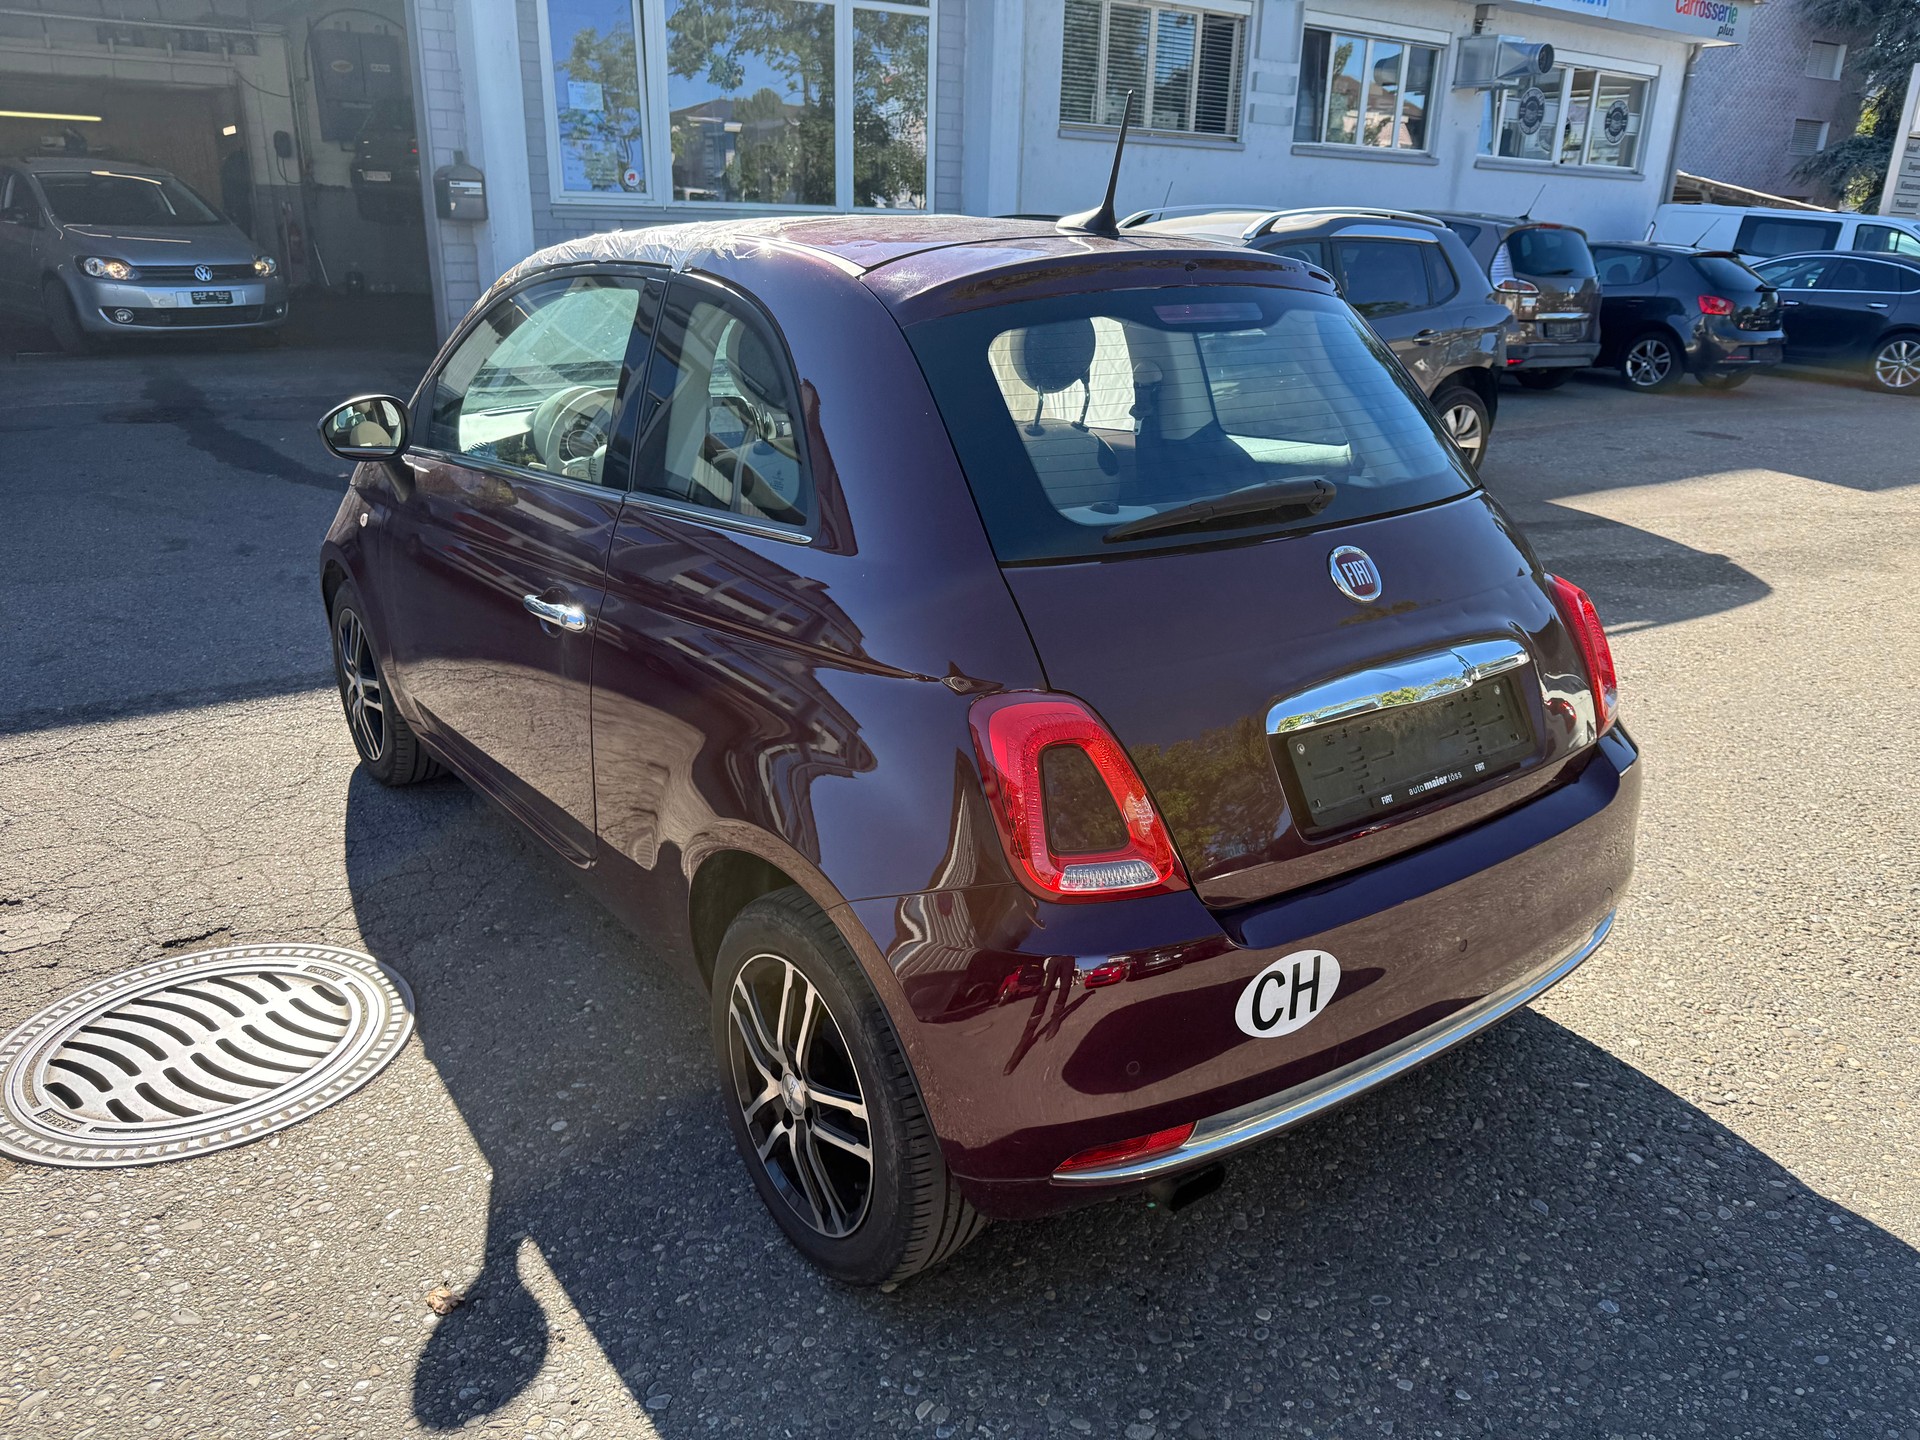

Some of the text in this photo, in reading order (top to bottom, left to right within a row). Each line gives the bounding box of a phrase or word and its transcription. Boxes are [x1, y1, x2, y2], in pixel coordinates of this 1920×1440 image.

[1675, 0, 1738, 24] Carrosserie
[1717, 24, 1735, 37] plus
[1341, 559, 1373, 588] FIAT
[1474, 762, 1486, 772] FIAT
[1381, 794, 1394, 805] FIAT
[1251, 954, 1322, 1031] CH
